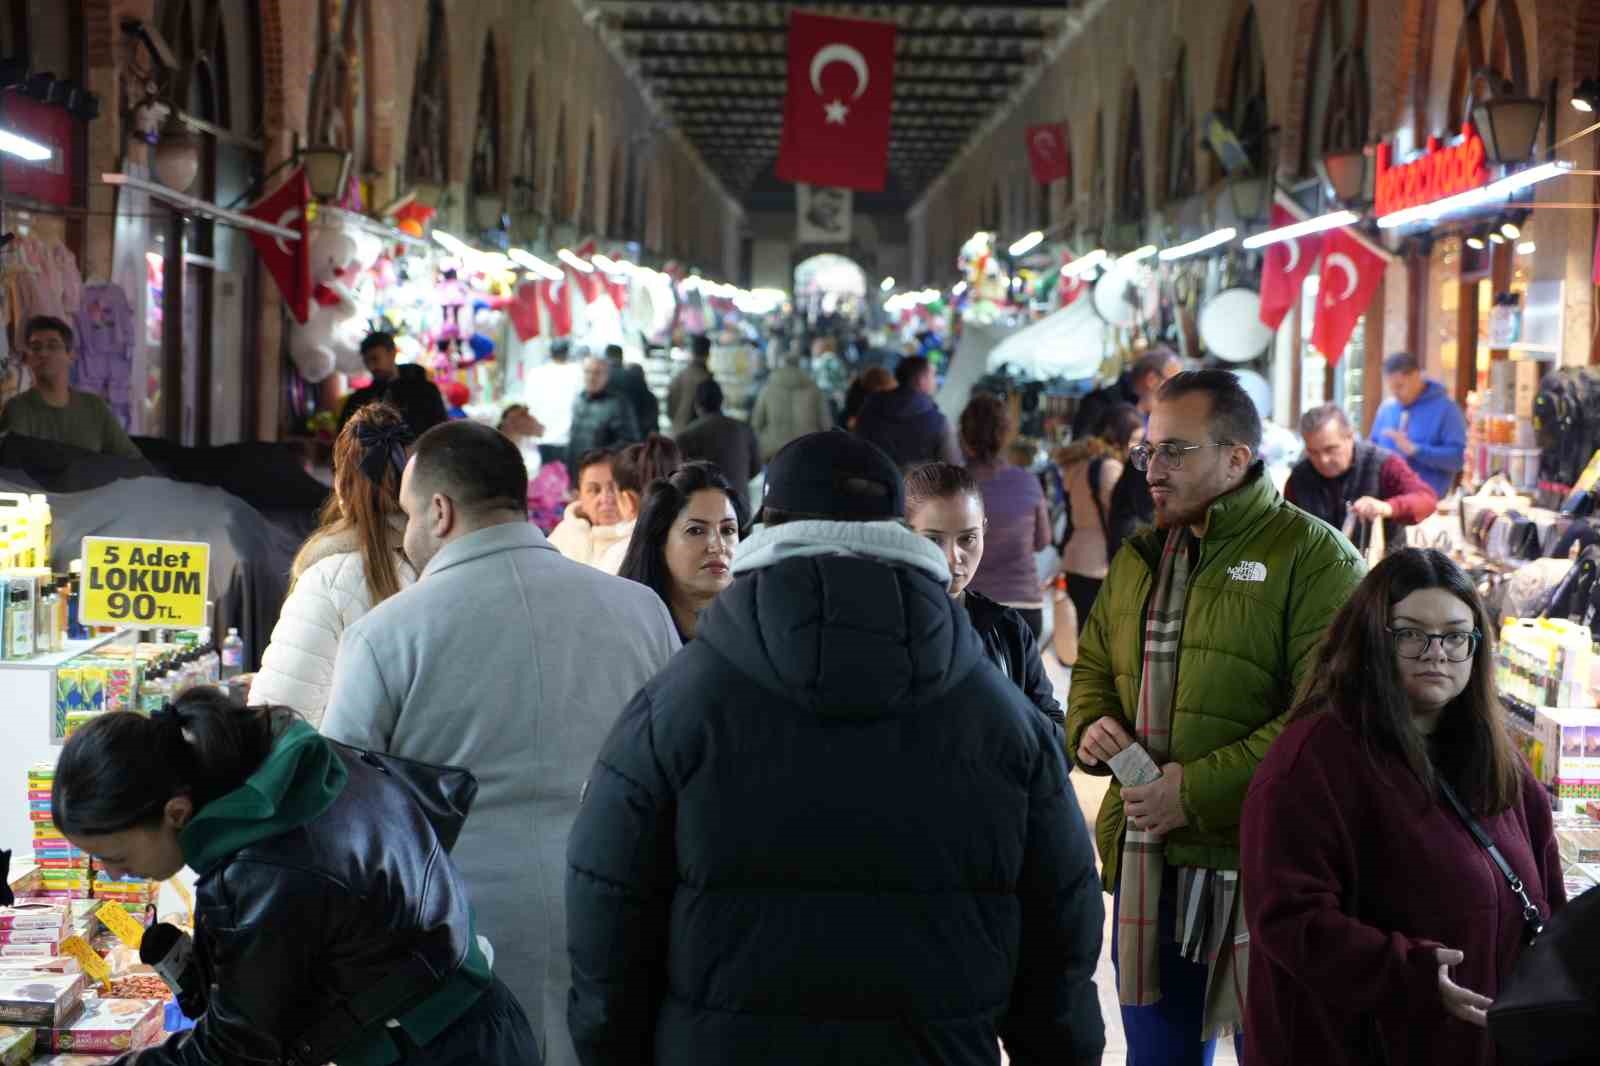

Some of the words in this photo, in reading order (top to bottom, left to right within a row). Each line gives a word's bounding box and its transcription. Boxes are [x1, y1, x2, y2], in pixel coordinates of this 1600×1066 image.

[104, 546, 120, 564] 5
[128, 547, 191, 568] Adet
[89, 567, 201, 595] LOKUM
